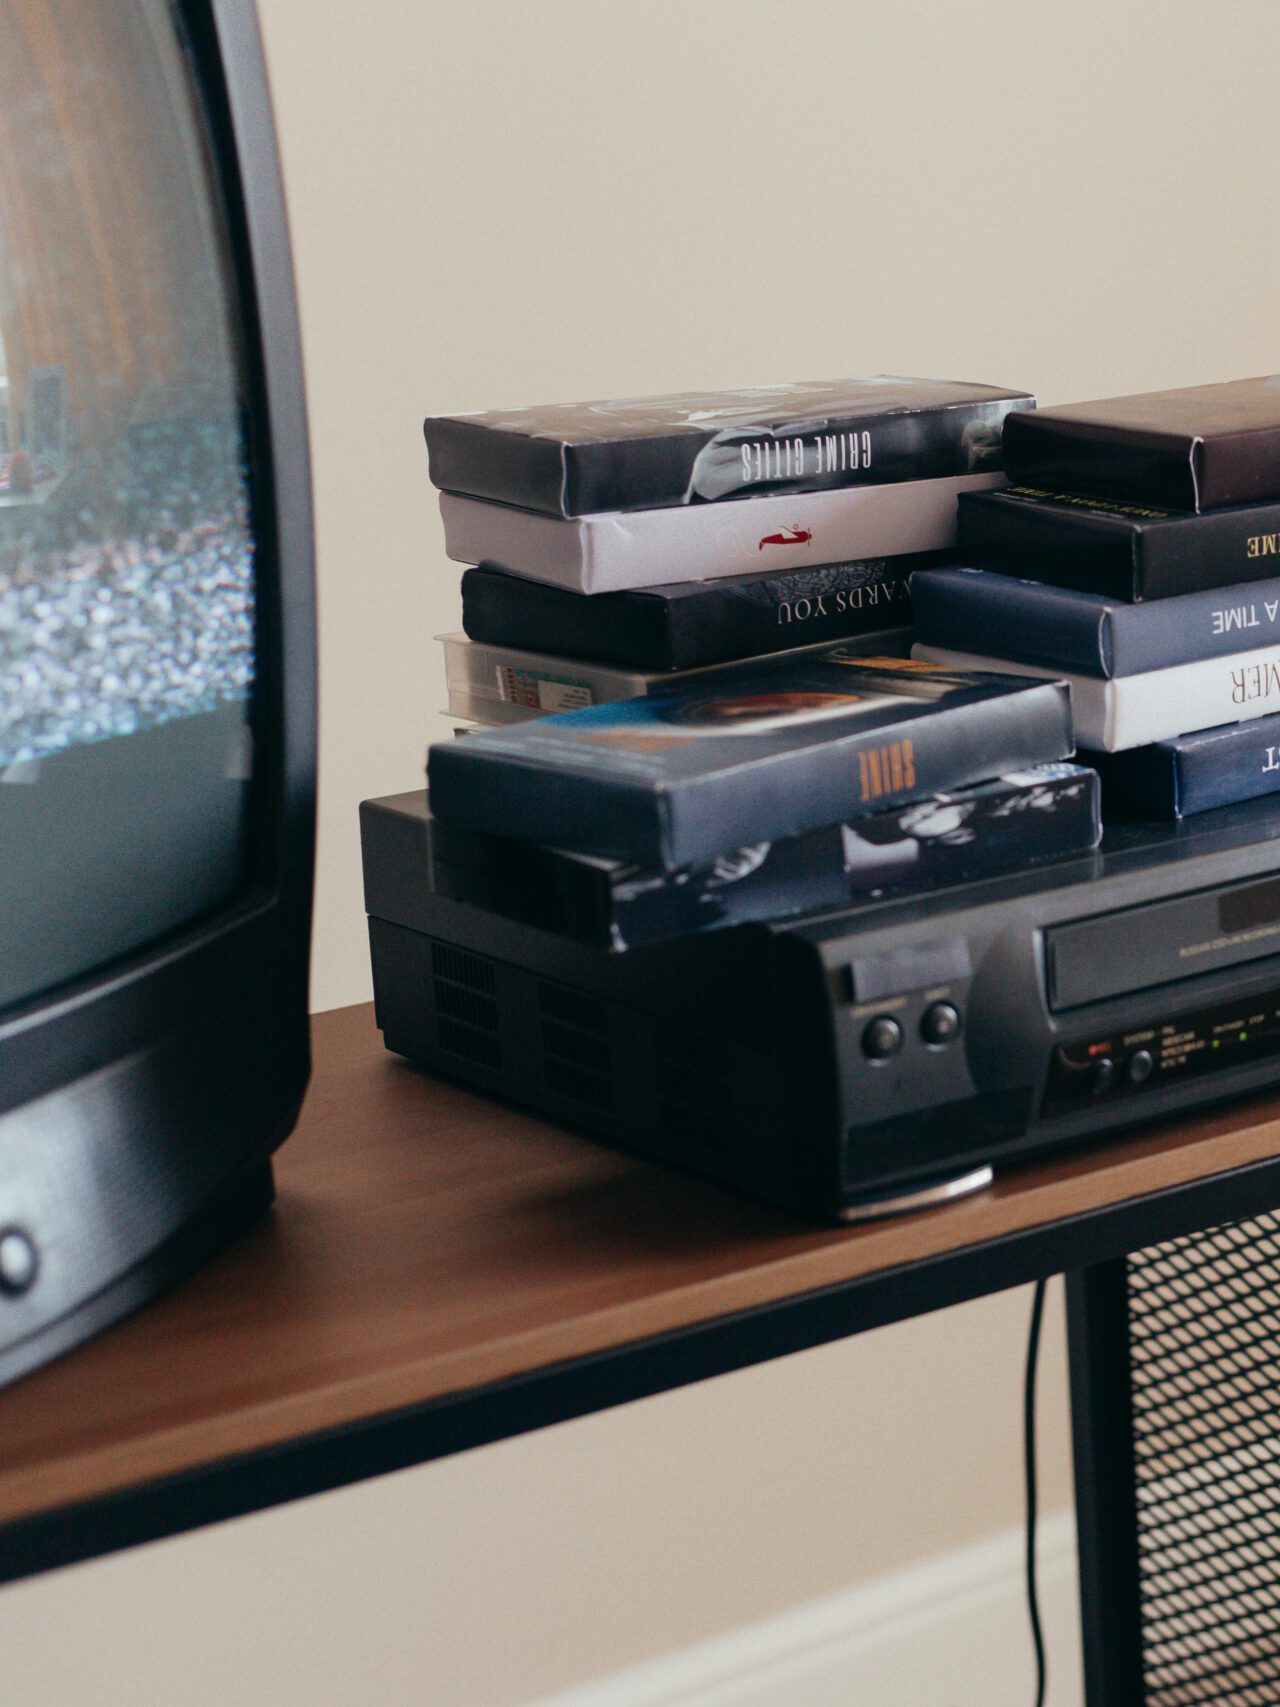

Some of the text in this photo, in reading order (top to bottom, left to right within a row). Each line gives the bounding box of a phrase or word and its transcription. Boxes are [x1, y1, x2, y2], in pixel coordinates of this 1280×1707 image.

[741, 431, 872, 482] CRIME CITIES
[777, 595, 828, 625] YOU
[1211, 605, 1261, 635] TIME
[1264, 600, 1279, 622] A
